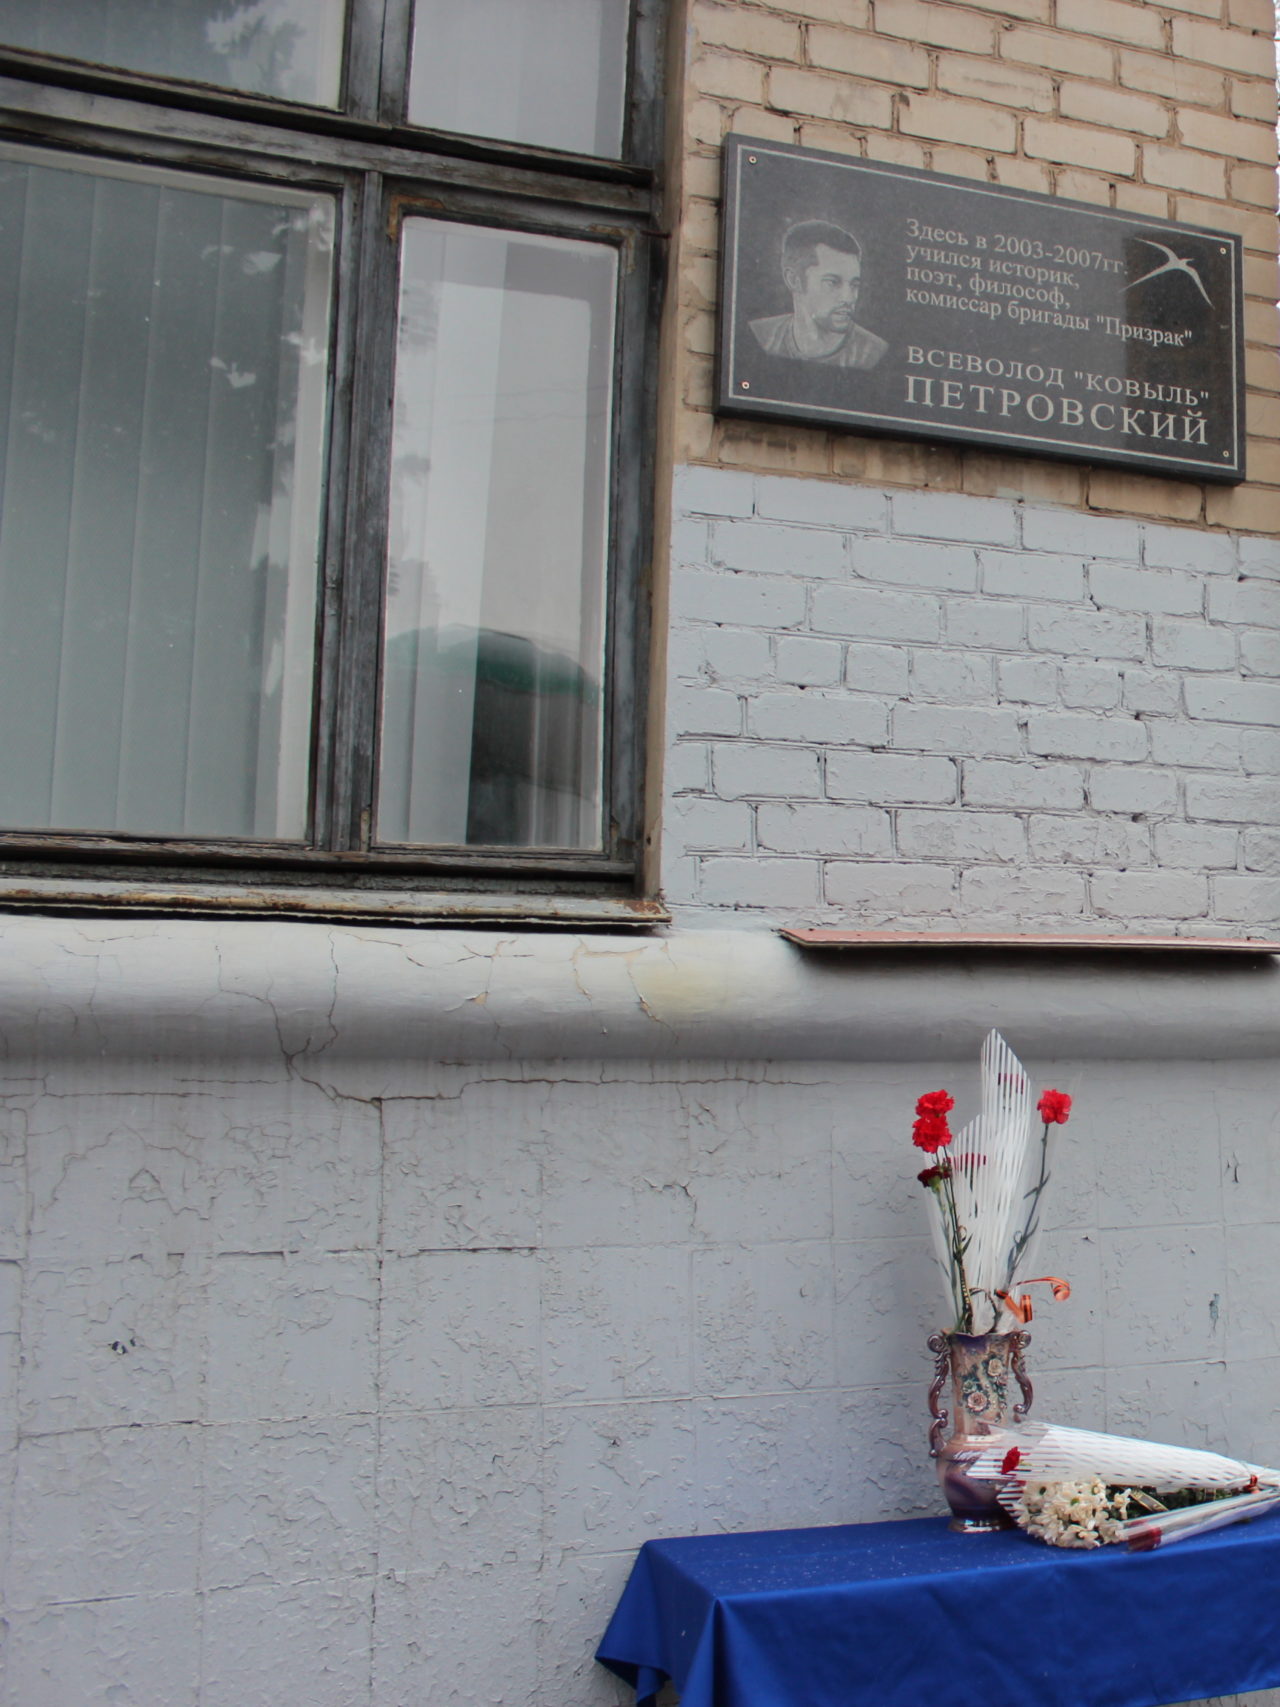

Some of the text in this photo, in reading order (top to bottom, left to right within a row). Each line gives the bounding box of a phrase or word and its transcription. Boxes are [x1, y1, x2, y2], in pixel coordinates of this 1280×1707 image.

[906, 217, 1128, 275] Здесь в 2003-2007гг.
[906, 244, 1080, 290] учился историк,
[905, 287, 1192, 347] комиссар бригады "Призрак"
[906, 266, 1071, 310] поэт, философ,
[907, 345, 1209, 407] ВСЕВОЛОД "КОВЫЛЬ"
[904, 374, 1209, 446] ПЕТРОВСКИЙ
